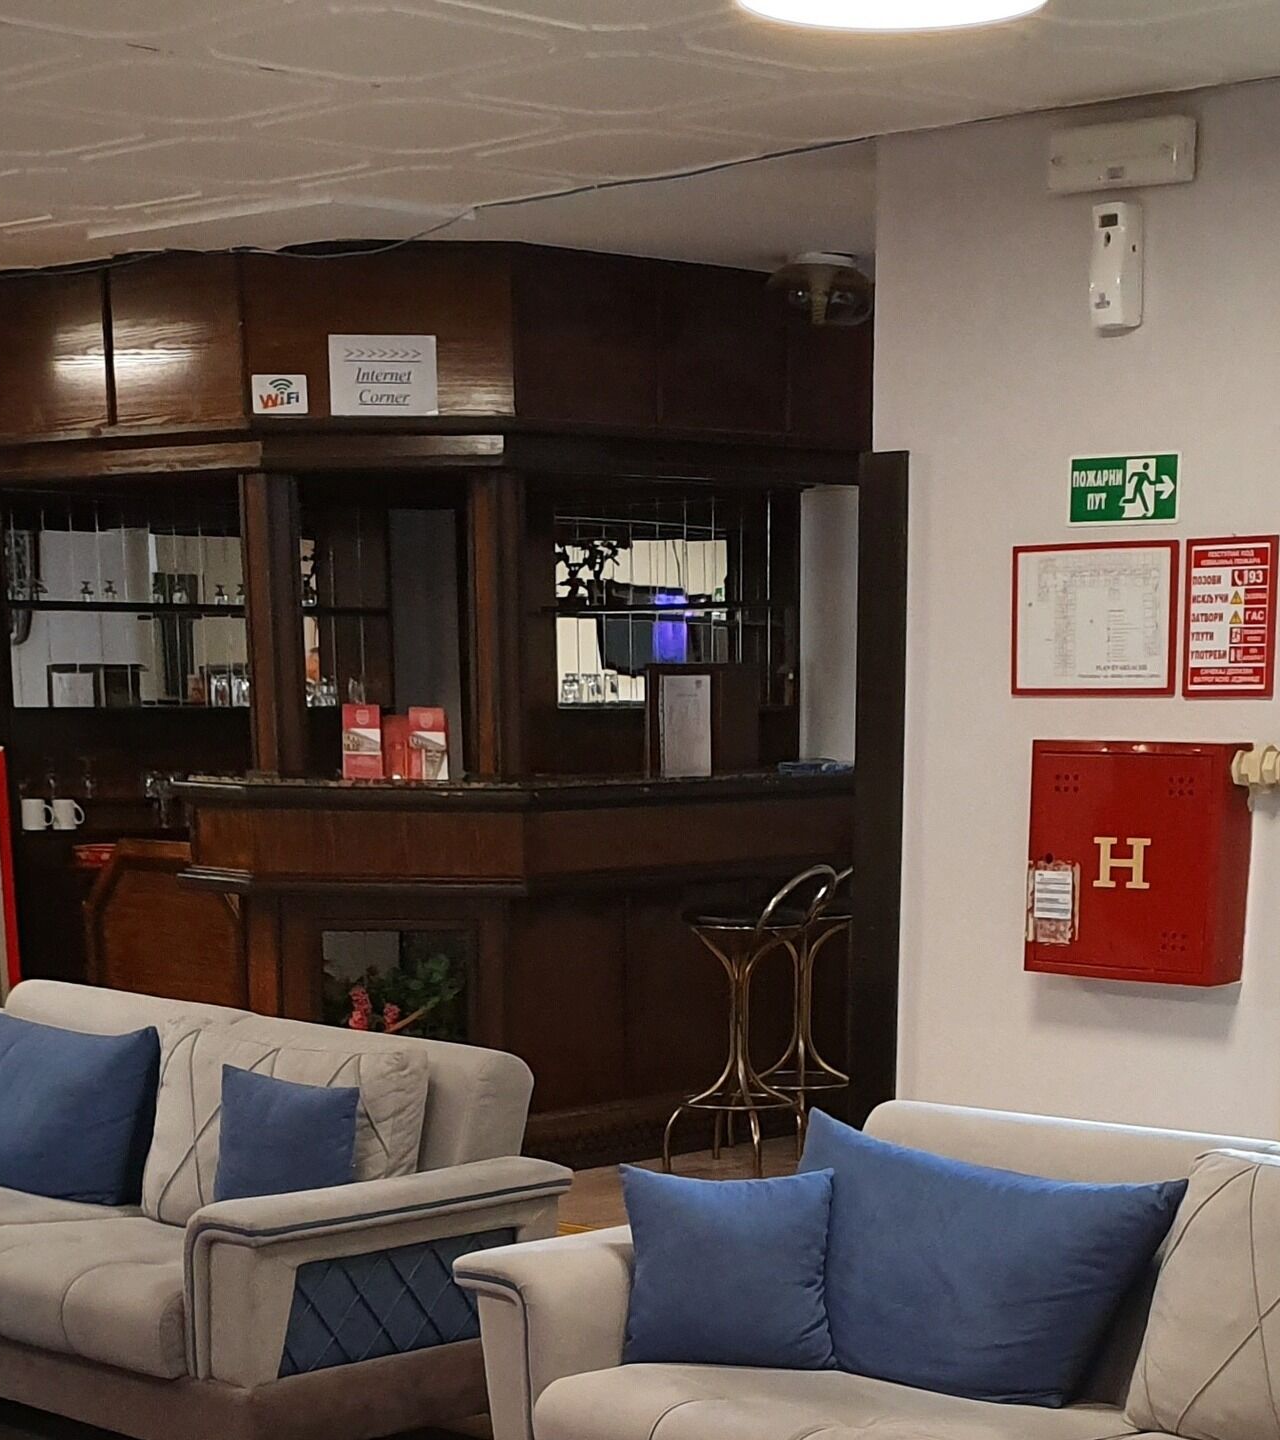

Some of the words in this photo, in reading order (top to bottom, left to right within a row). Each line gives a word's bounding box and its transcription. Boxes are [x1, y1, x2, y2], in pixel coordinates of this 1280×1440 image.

[355, 367, 412, 382] Internet
[259, 391, 300, 409] WiFi
[358, 389, 411, 405] Corner
[1073, 469, 1123, 488] ПОЖАРНИ
[1087, 492, 1107, 510] ПУТ
[1242, 569, 1264, 585] 193
[1191, 612, 1223, 622] ЗАТВОРИ
[1245, 610, 1264, 621] ГАС
[1093, 836, 1151, 889] H
